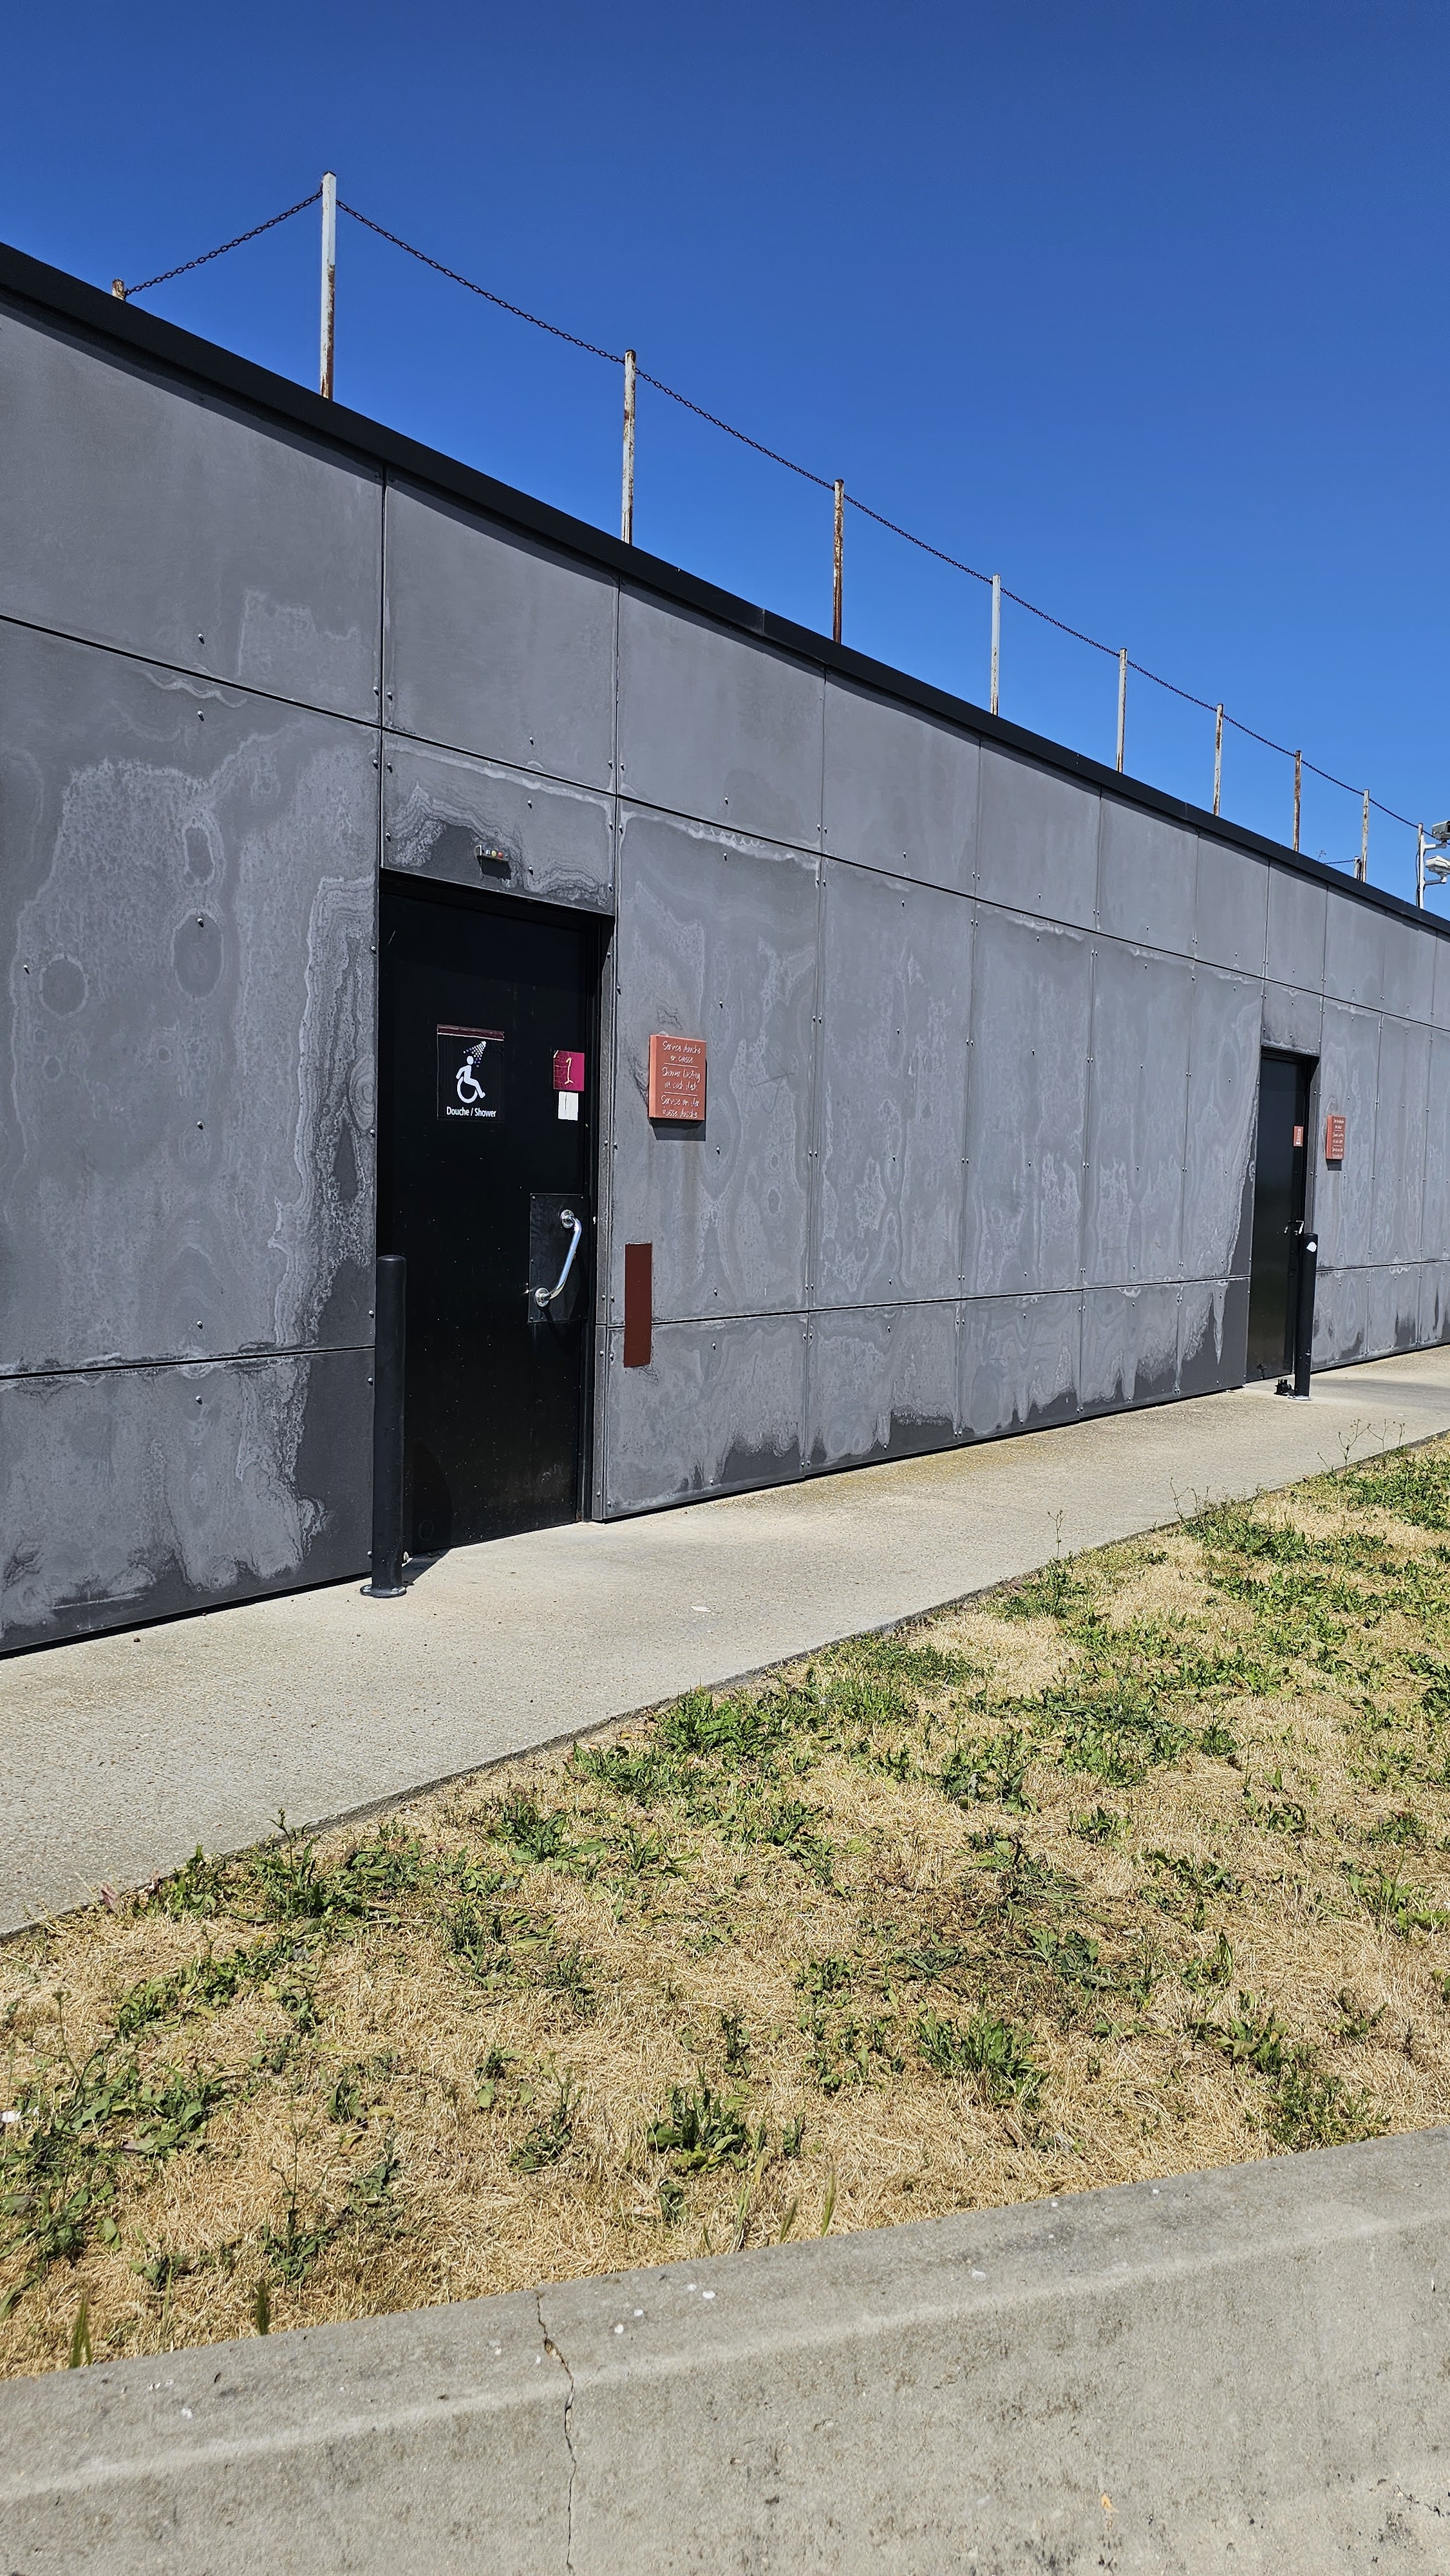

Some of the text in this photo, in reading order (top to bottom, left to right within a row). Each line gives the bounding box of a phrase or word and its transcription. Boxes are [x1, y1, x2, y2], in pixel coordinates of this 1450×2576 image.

[564, 1057, 574, 1085] 1
[446, 1106, 470, 1116] Douche
[474, 1107, 497, 1118] Shower
